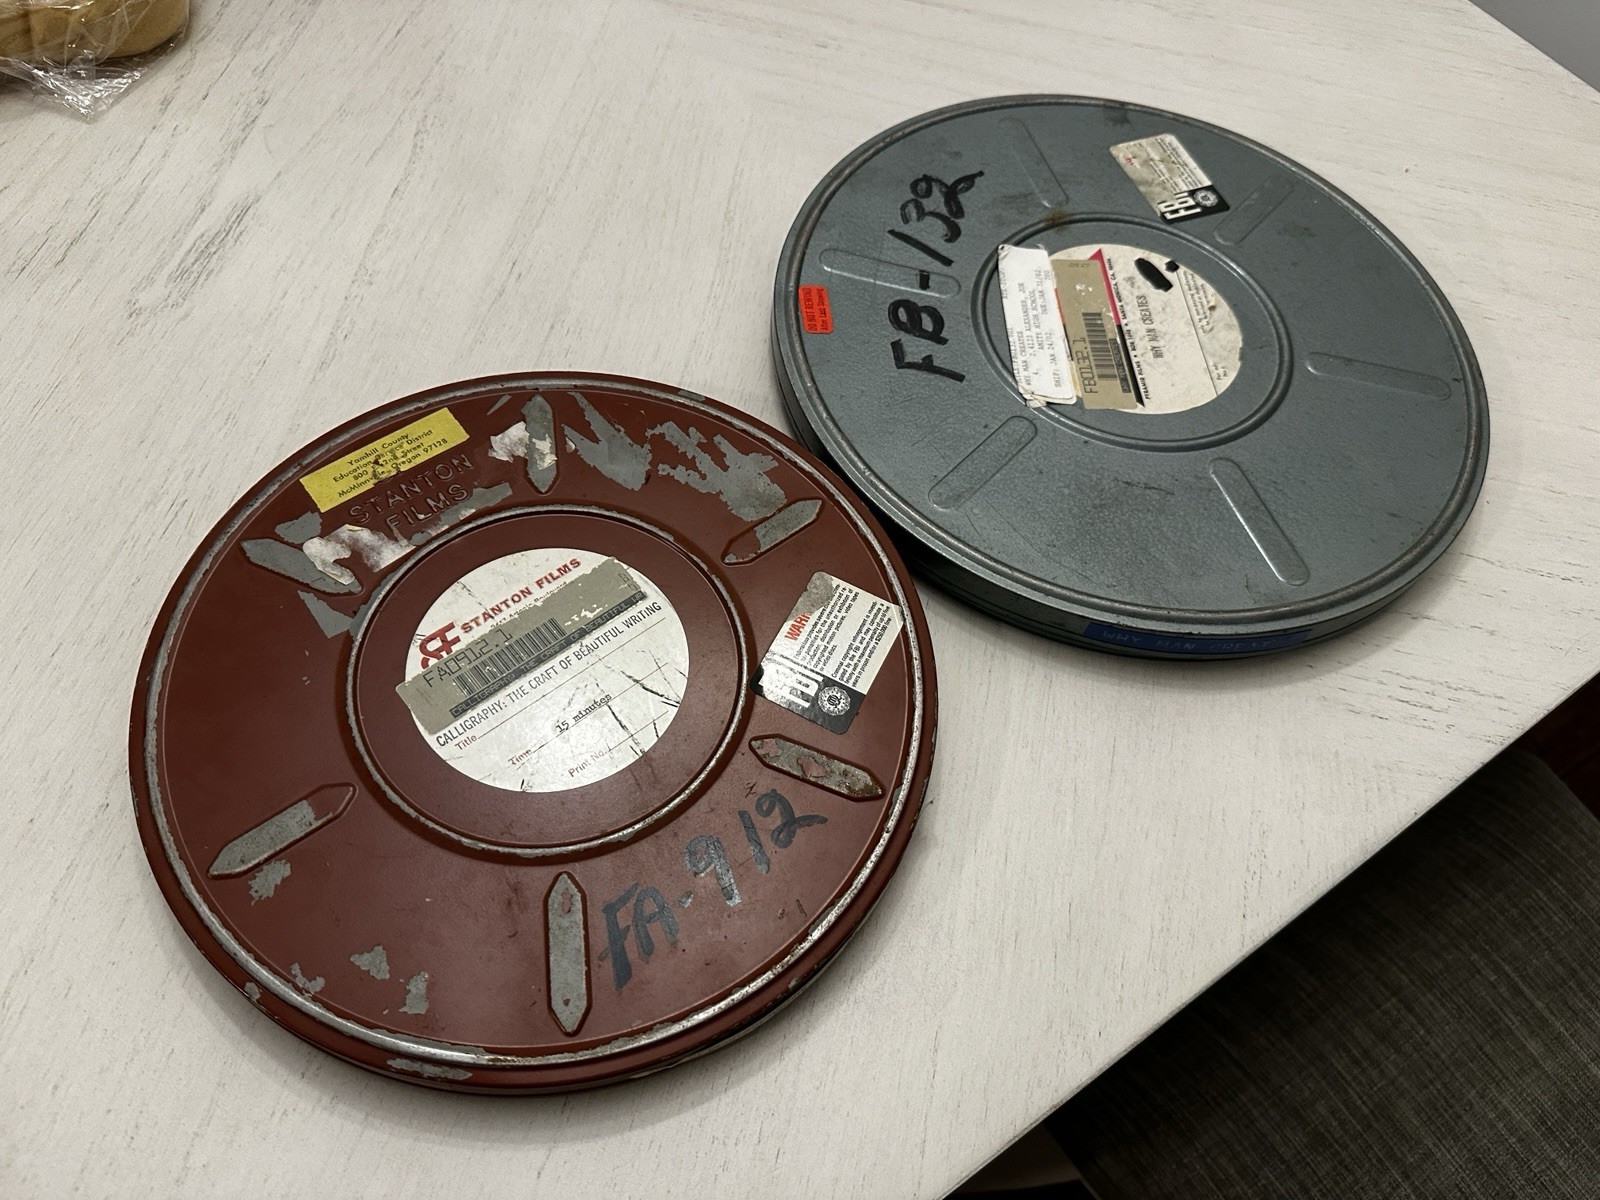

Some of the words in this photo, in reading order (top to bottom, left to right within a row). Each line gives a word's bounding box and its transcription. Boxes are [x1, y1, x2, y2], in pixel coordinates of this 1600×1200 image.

[887, 170, 985, 382] FB-132
[1032, 314, 1040, 328] HIGH
[1136, 295, 1153, 325] CREATES
[1035, 332, 1044, 350] AMITY
[1071, 337, 1098, 393] FB0132.1
[1134, 360, 1143, 375] FILMS
[1138, 377, 1150, 399] PYRAMID
[332, 459, 373, 482] Education
[405, 428, 433, 445] District
[346, 447, 379, 467] Yamhill
[380, 432, 410, 450] County
[422, 437, 448, 454] 97128
[350, 453, 473, 524] STANTON
[386, 484, 468, 532] FILMS
[458, 583, 533, 635] STANTON
[534, 555, 582, 590] FILMS
[819, 619, 827, 627] the
[824, 591, 843, 620] unauthorized
[806, 620, 819, 638] provides
[816, 607, 826, 621] severe
[819, 619, 835, 642] distribution
[836, 593, 849, 613] exhibition
[825, 630, 836, 645] motion
[843, 602, 852, 613] video
[849, 590, 859, 603] tapes
[519, 658, 539, 673] THE
[539, 640, 567, 660] CRAFT
[568, 629, 583, 642] OF
[584, 600, 630, 632] BEAUTIFUL
[852, 644, 860, 653] FBI
[857, 636, 865, 645] and
[863, 626, 871, 636] may
[858, 640, 871, 660] maximum
[867, 626, 879, 642] penalty
[421, 624, 513, 688] FA0912.1
[433, 696, 508, 748] CALLIGRAPHY:
[504, 683, 529, 704] THE
[526, 664, 560, 690] CRAFT
[557, 654, 575, 671] OF
[572, 623, 625, 661] BEAUTIFUL
[620, 599, 662, 630] WRITING
[821, 654, 831, 666] video
[830, 660, 843, 678] Criminal
[840, 641, 855, 661] copyright
[859, 657, 870, 671] prison
[555, 719, 570, 733] 15
[572, 693, 612, 722] minutes
[454, 732, 478, 751] Title
[508, 749, 533, 766] Time
[568, 760, 591, 777] Print
[599, 789, 828, 991] FA-912
